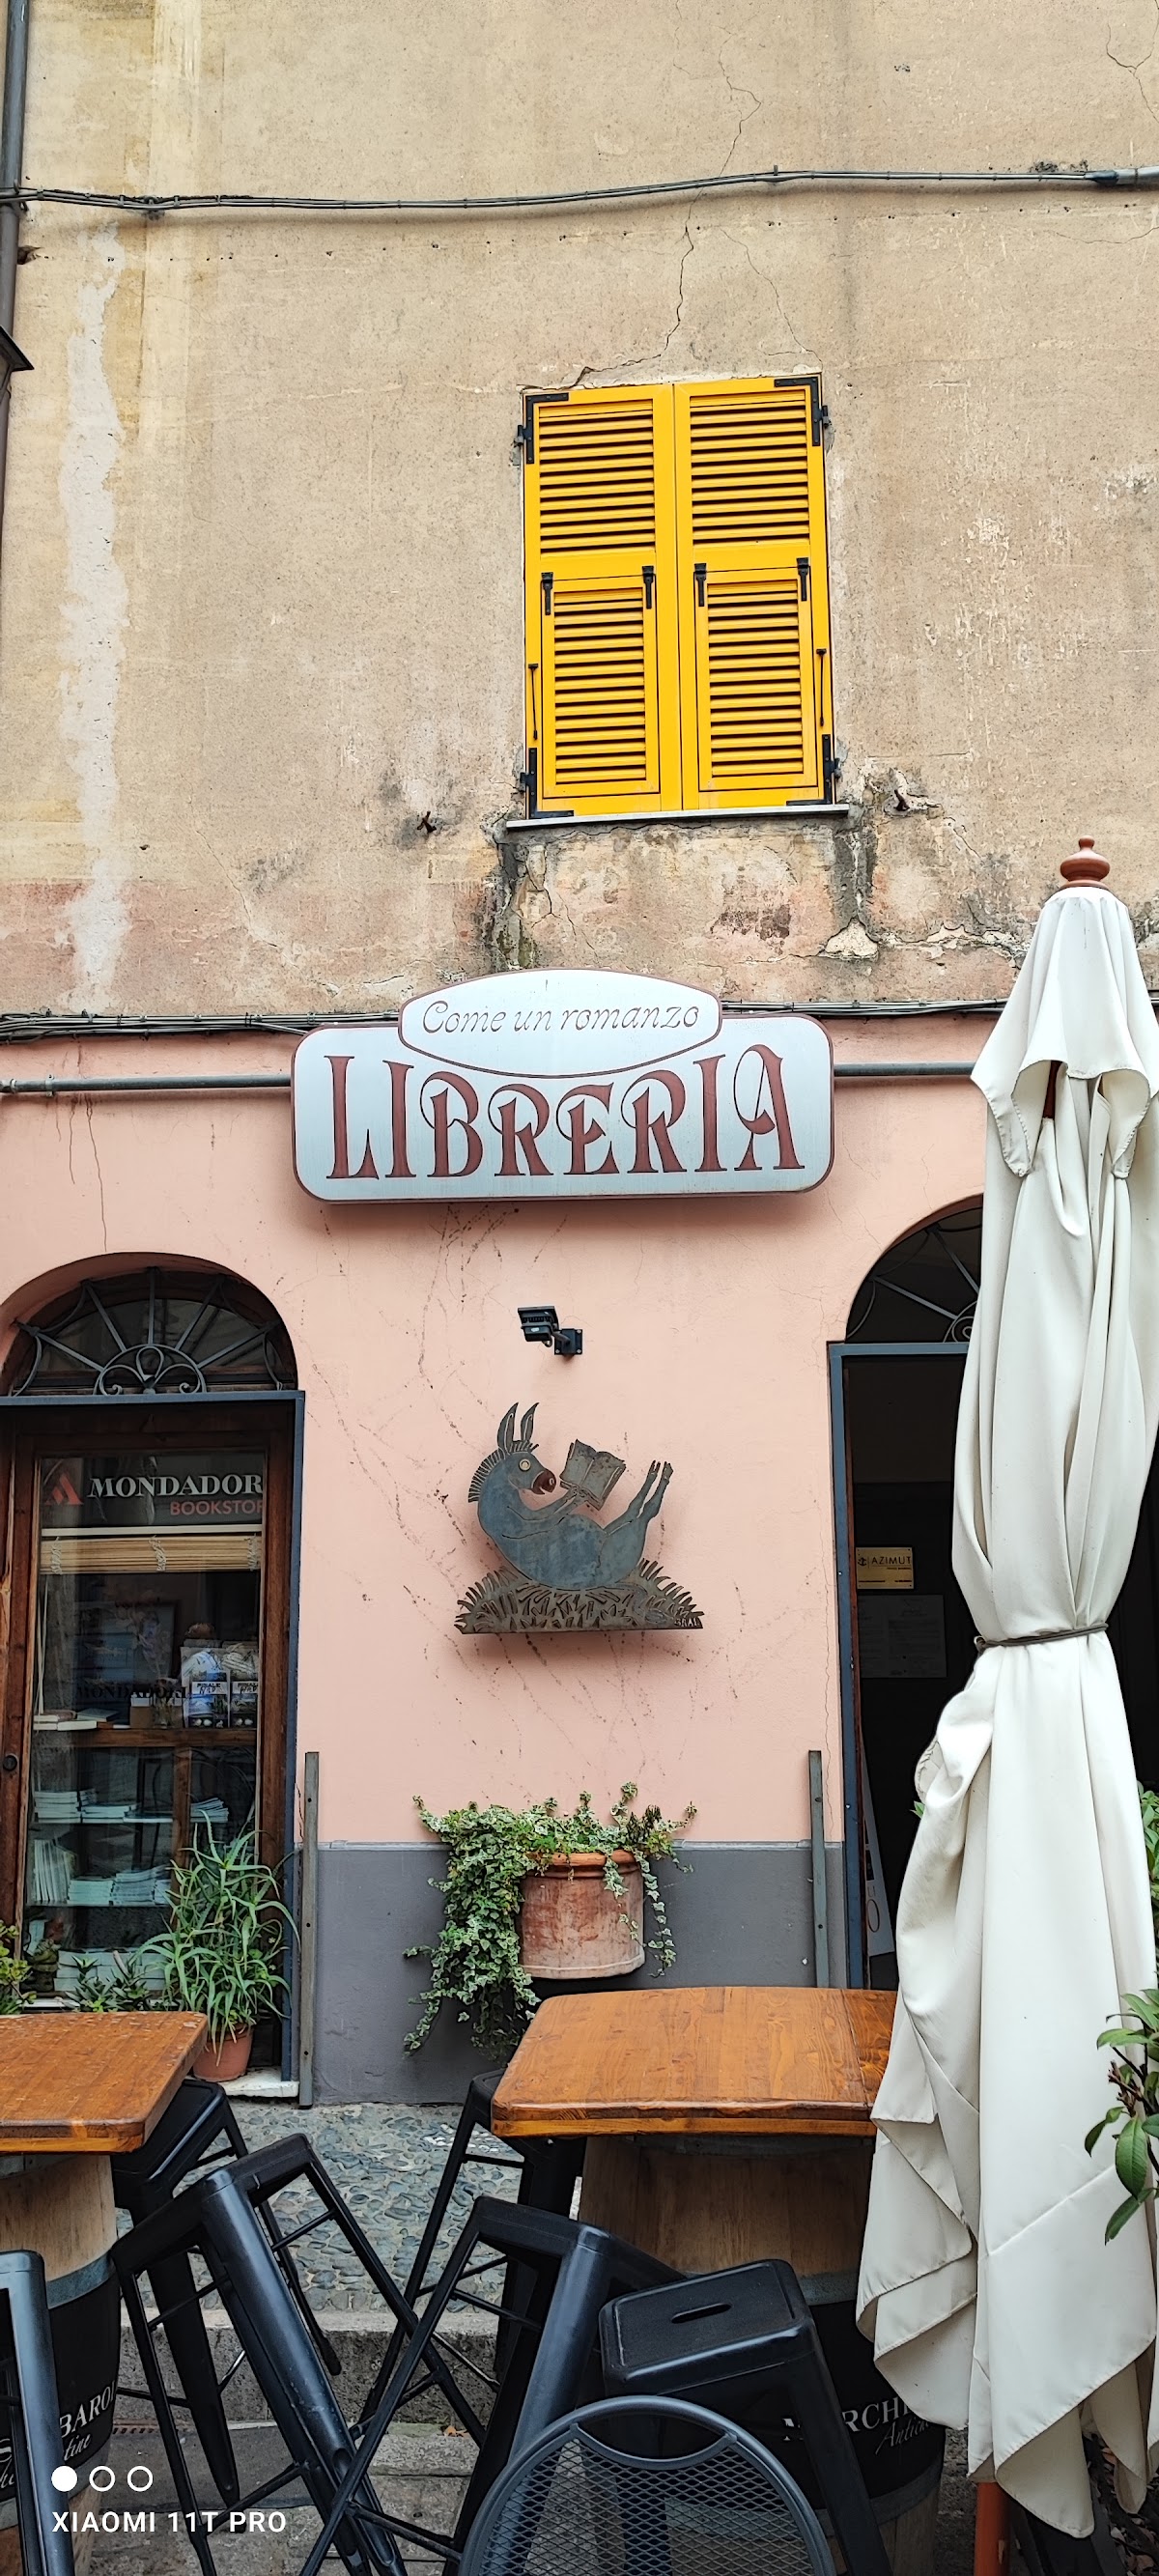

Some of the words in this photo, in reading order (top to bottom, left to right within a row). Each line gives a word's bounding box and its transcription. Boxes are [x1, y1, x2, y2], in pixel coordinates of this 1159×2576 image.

[422, 1000, 503, 1034] Come
[514, 1007, 552, 1032] un
[561, 1003, 700, 1032] romanzo
[324, 1043, 806, 1180] LIBRERIA
[87, 1474, 263, 1497] MONDADOR
[170, 1500, 263, 1515] BOOKSTO
[871, 1556, 912, 1565] AZIMUT
[63, 2433, 92, 2462] tine
[874, 2417, 929, 2456] Antic
